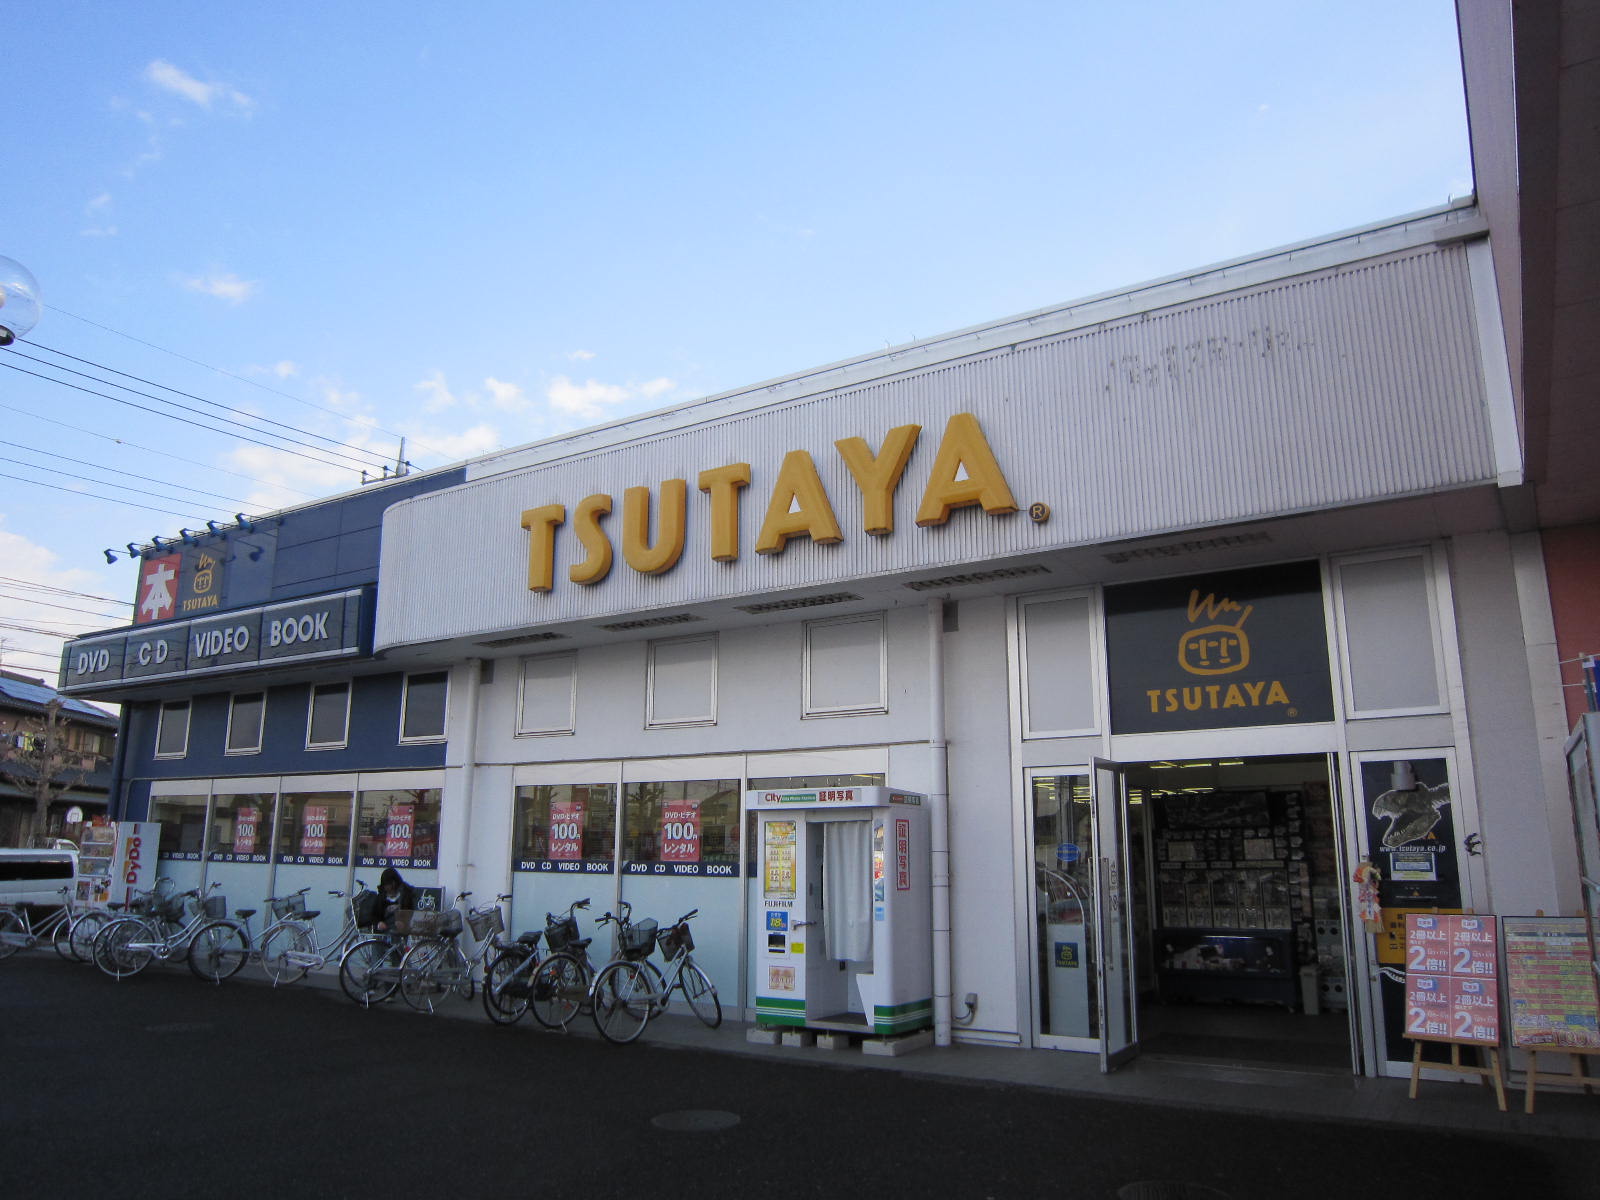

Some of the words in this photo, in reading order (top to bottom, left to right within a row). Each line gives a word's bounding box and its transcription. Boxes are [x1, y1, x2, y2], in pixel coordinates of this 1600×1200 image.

[521, 412, 1020, 594] TSUTAYA
[142, 564, 175, 620] 本
[183, 595, 218, 611] TSUTAYA
[77, 649, 110, 675] DVD
[139, 640, 168, 666] CD
[195, 626, 250, 657] VIDEO
[270, 611, 329, 647] BOOK
[1147, 681, 1290, 713] TSUTAYA
[552, 842, 579, 852] レンタル
[664, 843, 695, 853] レンタル
[126, 836, 142, 884] DyDo
[253, 854, 266, 862] BOOK
[283, 855, 294, 863] DVD
[309, 856, 324, 864] VIDEO
[328, 856, 343, 864] BOOK
[363, 857, 375, 865] DVD
[379, 858, 387, 866] CD
[392, 858, 409, 866] VIDEO
[414, 859, 431, 867] BOOK
[521, 861, 536, 869] DVD
[542, 862, 552, 870] CD
[558, 862, 580, 871] VIDEO
[587, 863, 608, 871] BOOK
[631, 864, 647, 872] DVD
[654, 864, 666, 872] CD
[674, 864, 699, 873] VIDEO
[707, 865, 732, 874] BOOK
